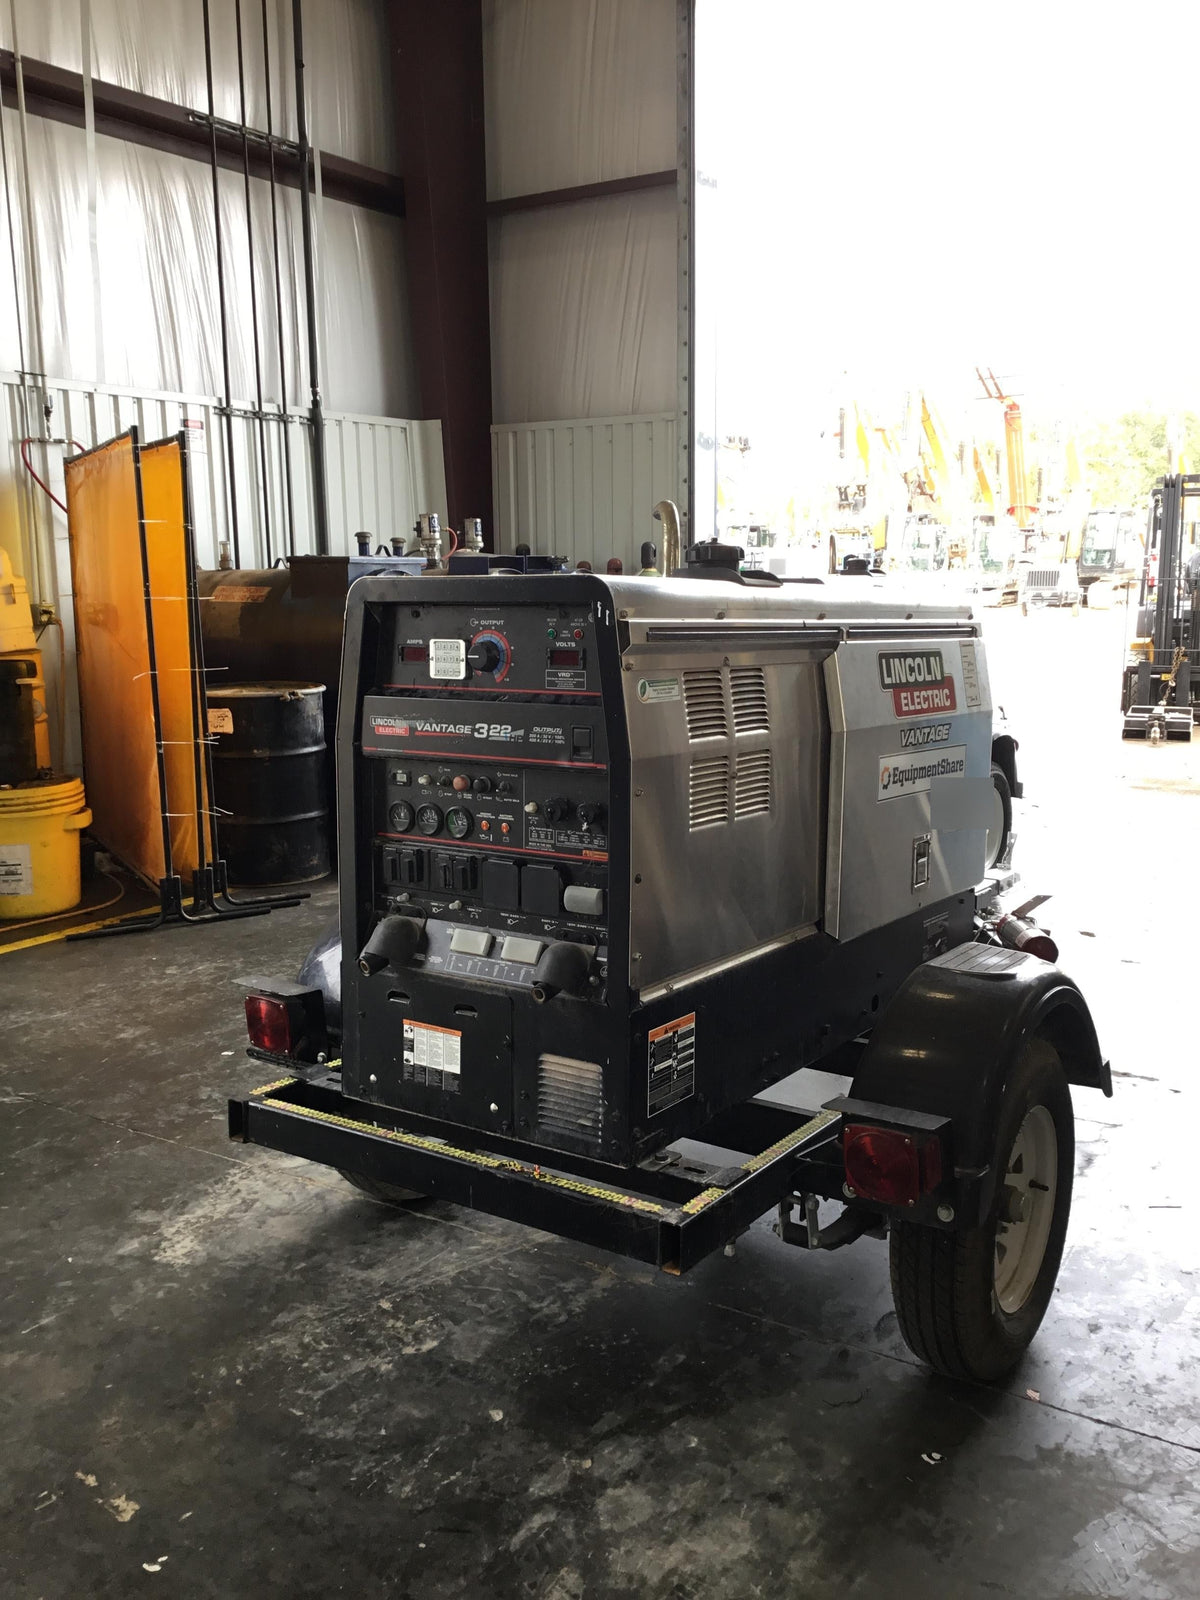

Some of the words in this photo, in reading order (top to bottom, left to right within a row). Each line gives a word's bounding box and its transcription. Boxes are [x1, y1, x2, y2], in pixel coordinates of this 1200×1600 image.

[882, 656, 942, 685] LINCOLN
[900, 688, 951, 712] ELECTRIC
[378, 726, 406, 735] ELECTRIC
[416, 722, 473, 734] VANTAGE
[473, 722, 512, 739] 322
[900, 723, 951, 747] VANTAGE
[891, 758, 964, 788] EquipmentShare
